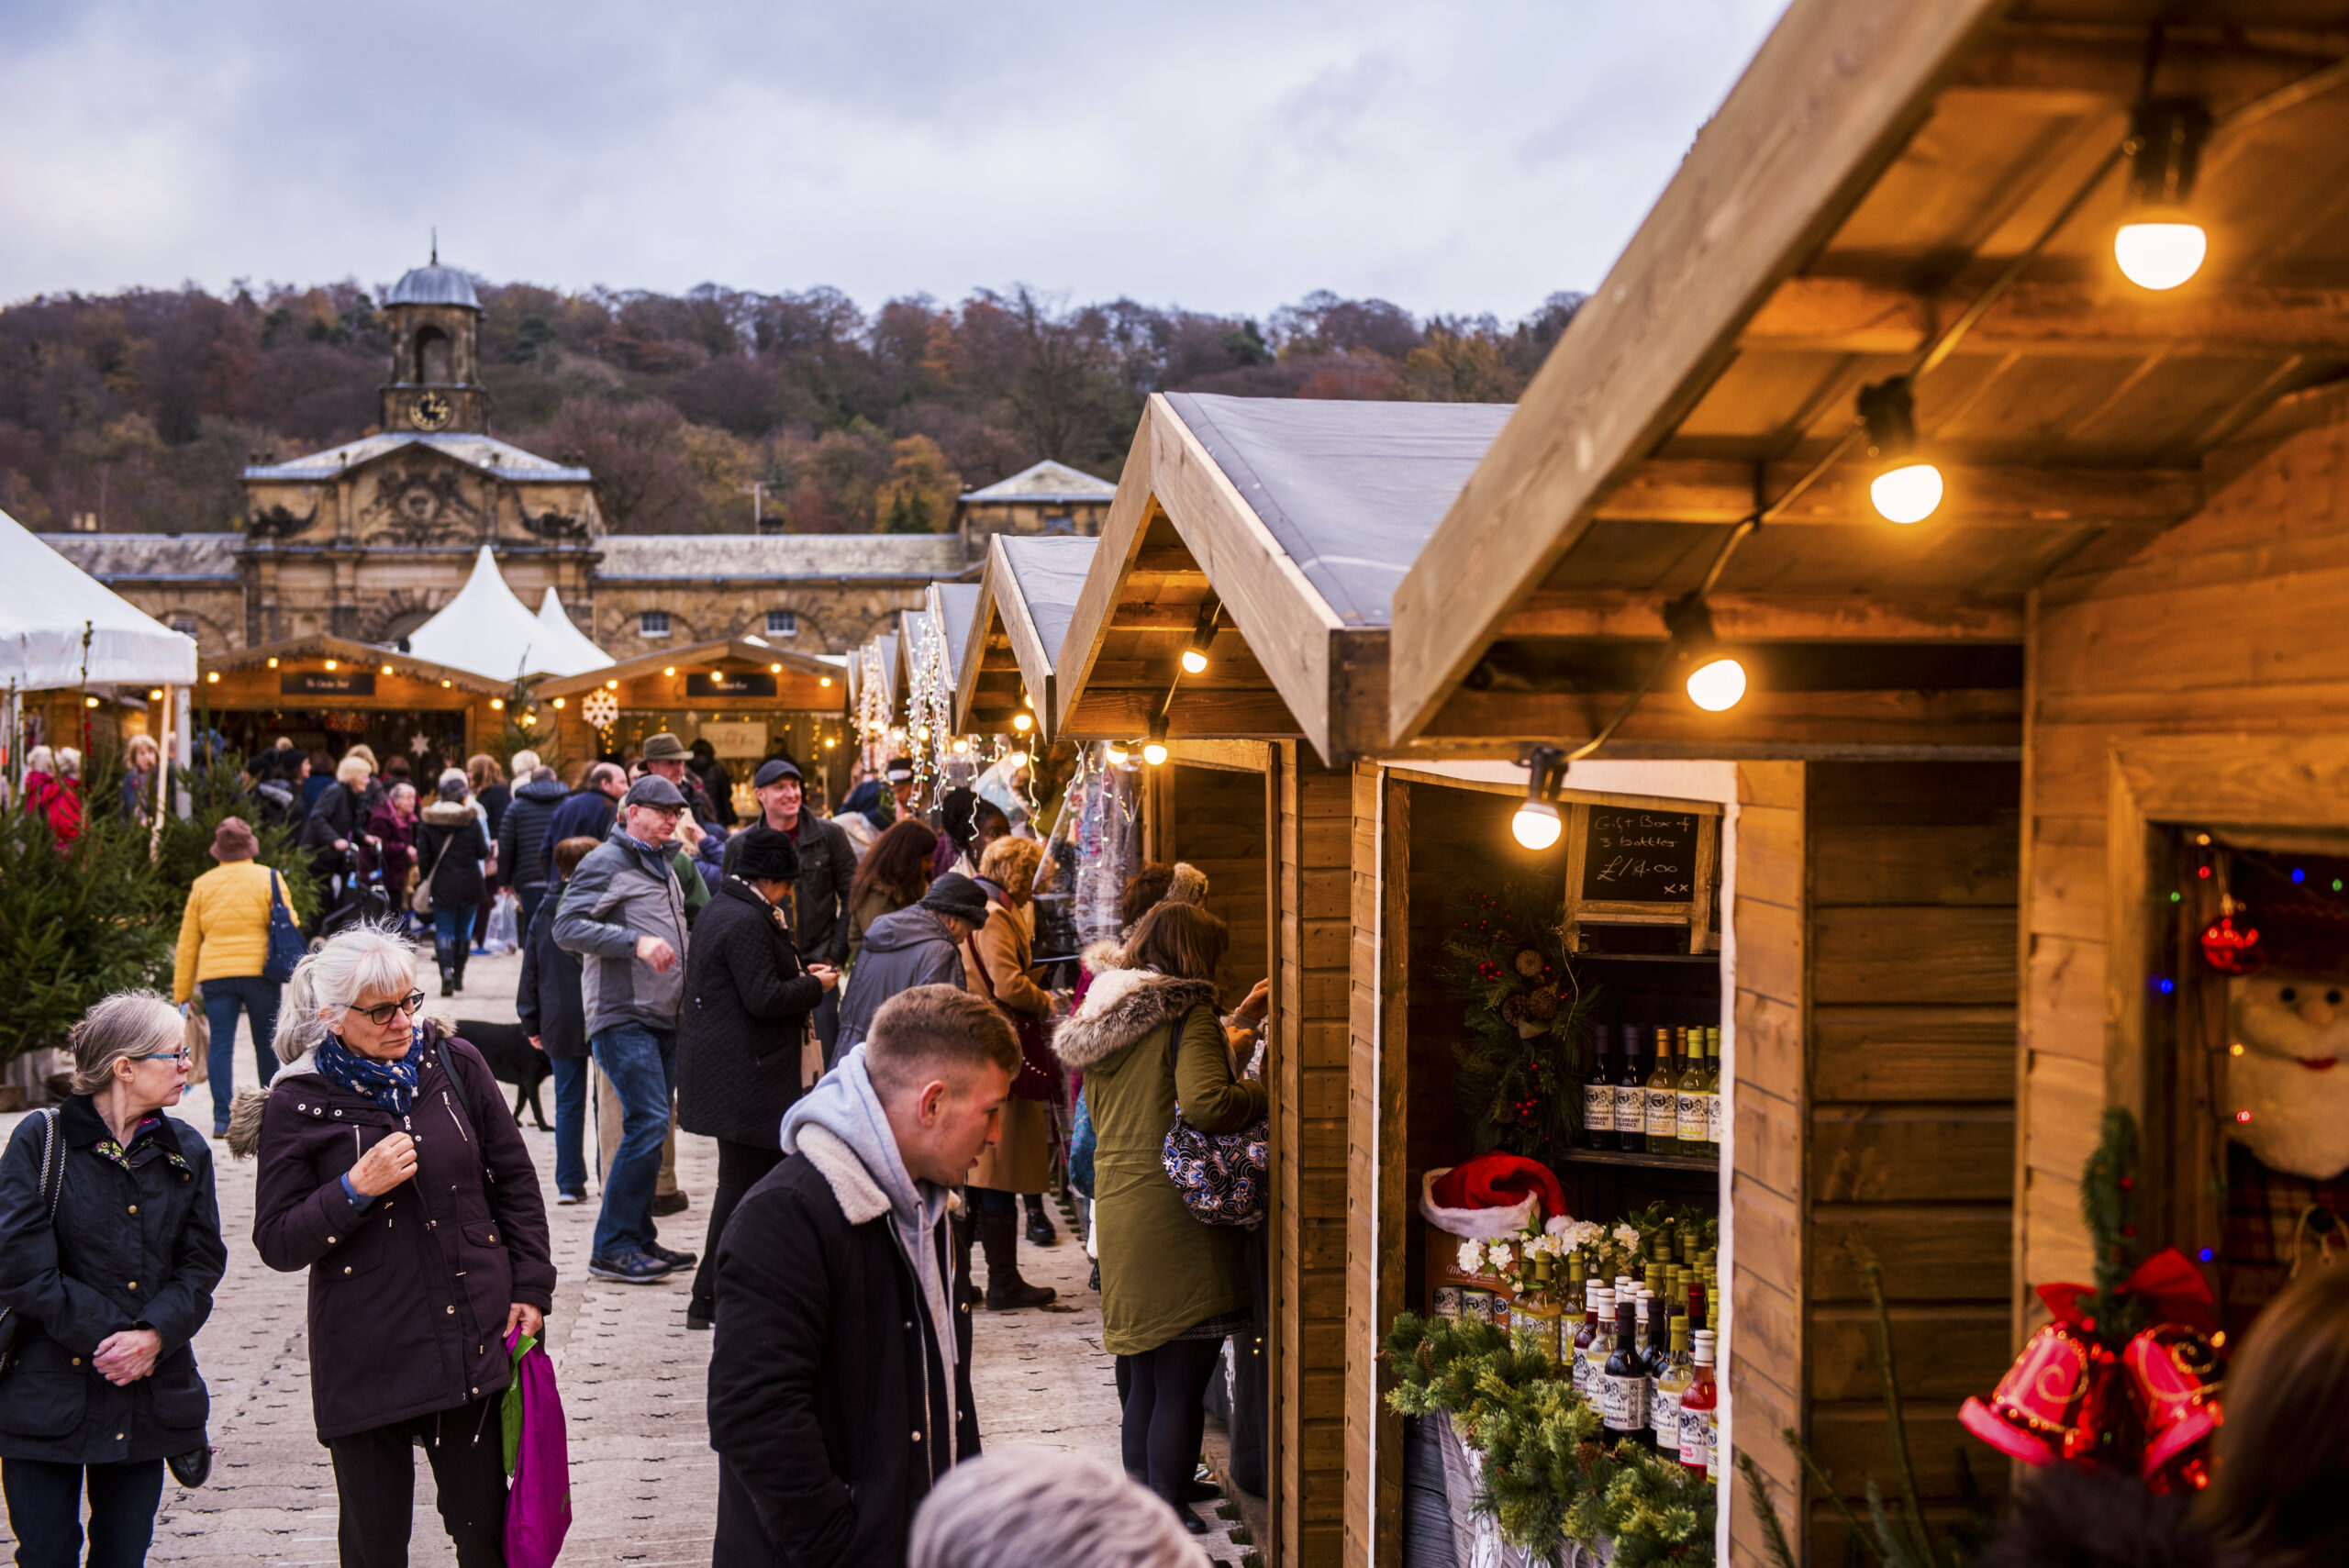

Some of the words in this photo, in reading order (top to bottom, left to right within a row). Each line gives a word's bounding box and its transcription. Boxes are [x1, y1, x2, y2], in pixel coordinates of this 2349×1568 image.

[1595, 816, 1635, 833] Gift
[1640, 815, 1671, 828] Box
[1676, 817, 1690, 832] of
[1599, 837, 1612, 848] 3
[1597, 855, 1678, 882] £14.00
